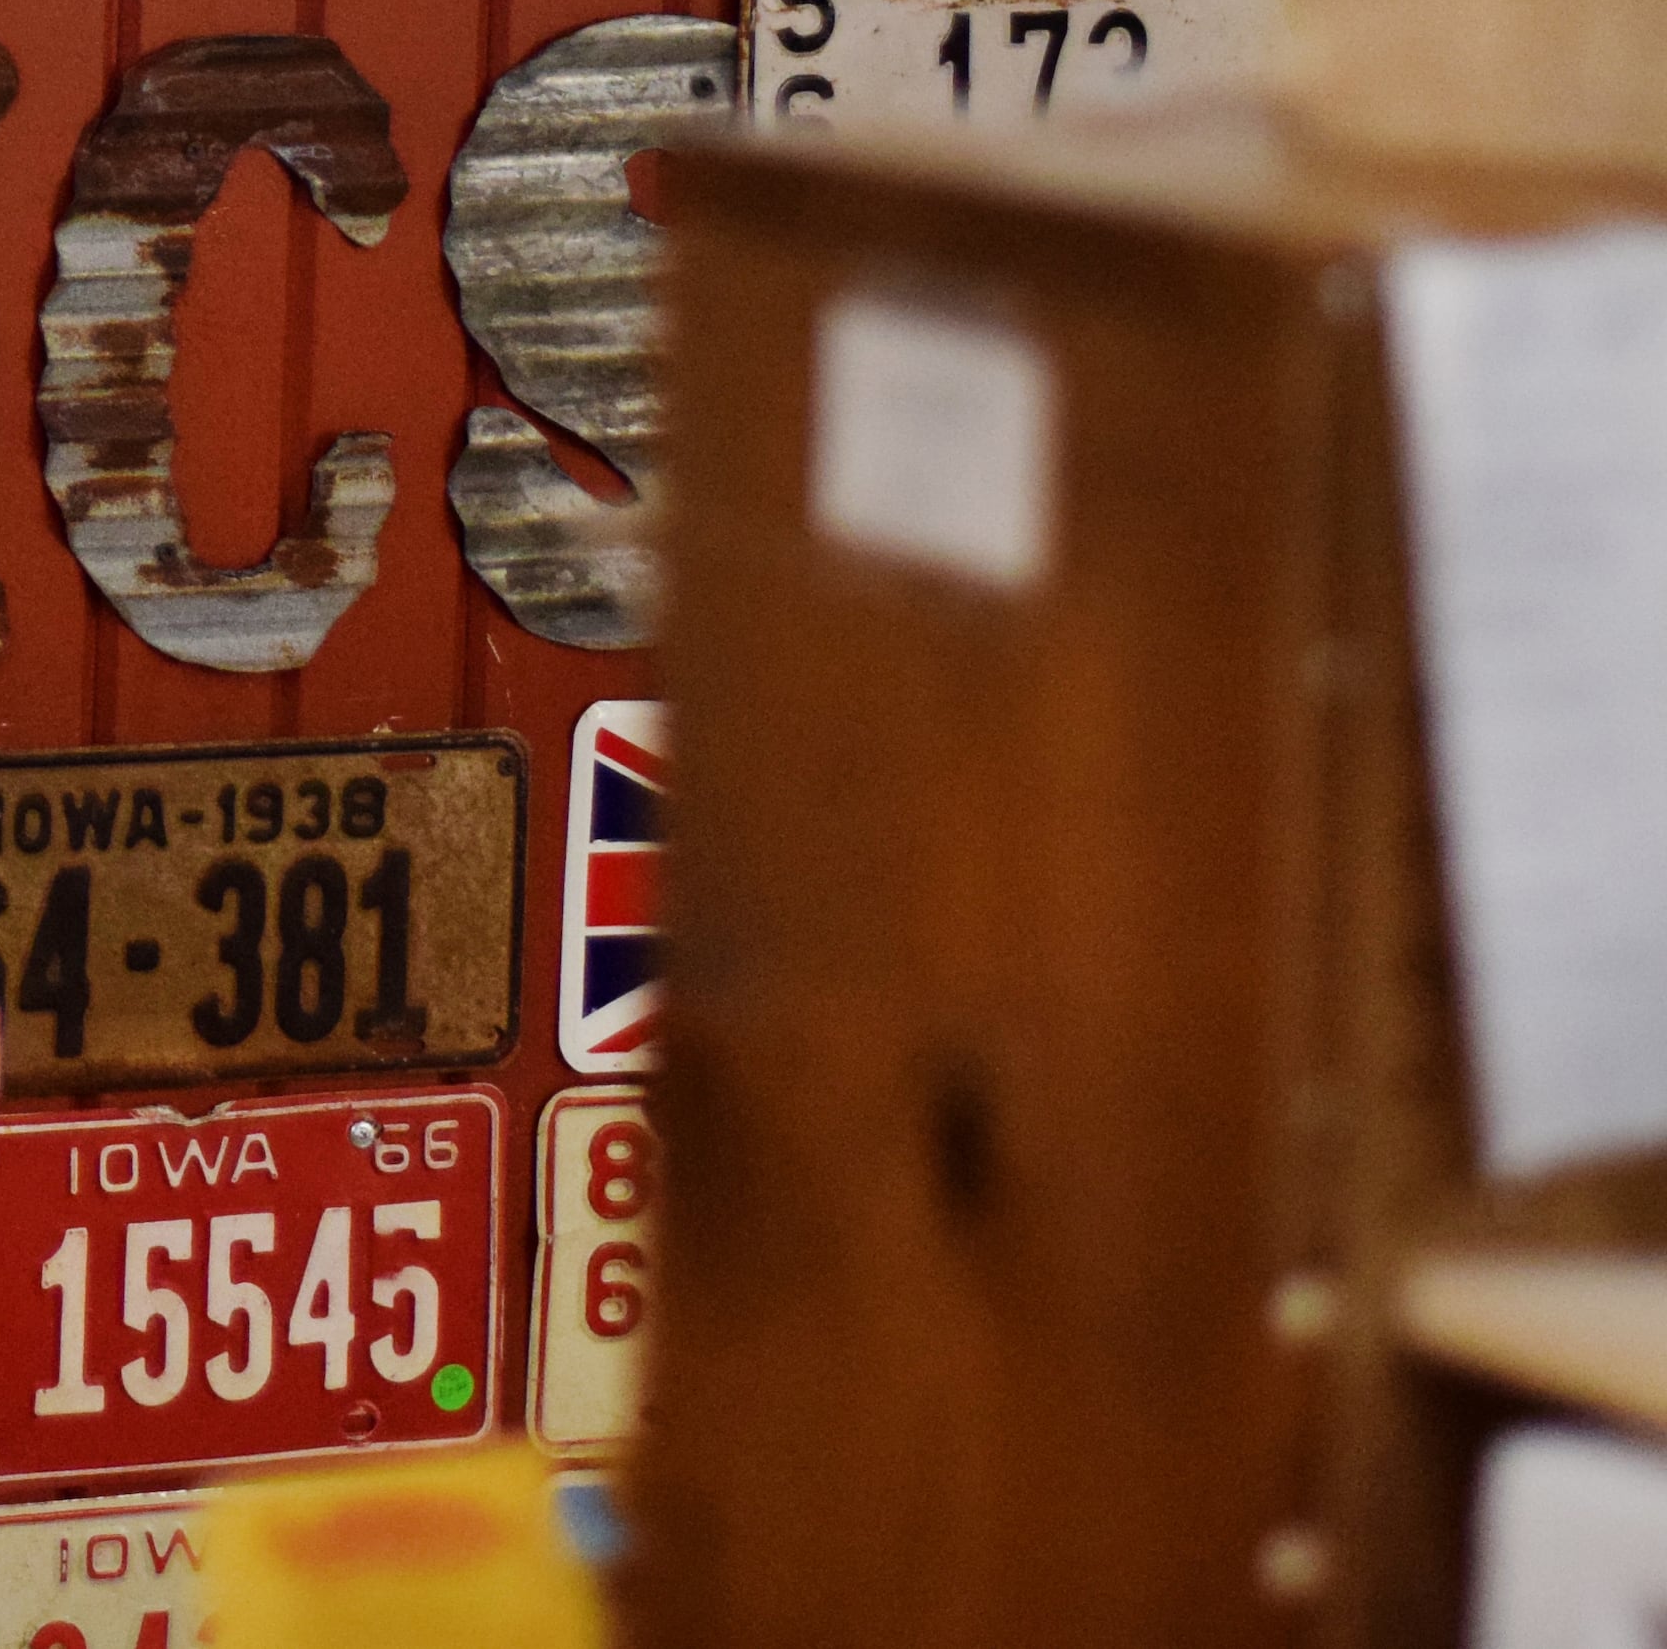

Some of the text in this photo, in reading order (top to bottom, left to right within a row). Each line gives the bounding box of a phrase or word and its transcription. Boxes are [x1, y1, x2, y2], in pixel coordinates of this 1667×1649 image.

[69, 1119, 461, 1196] IOWA 66
[34, 1198, 442, 1418] 15545
[58, 1528, 204, 1583] IOW
